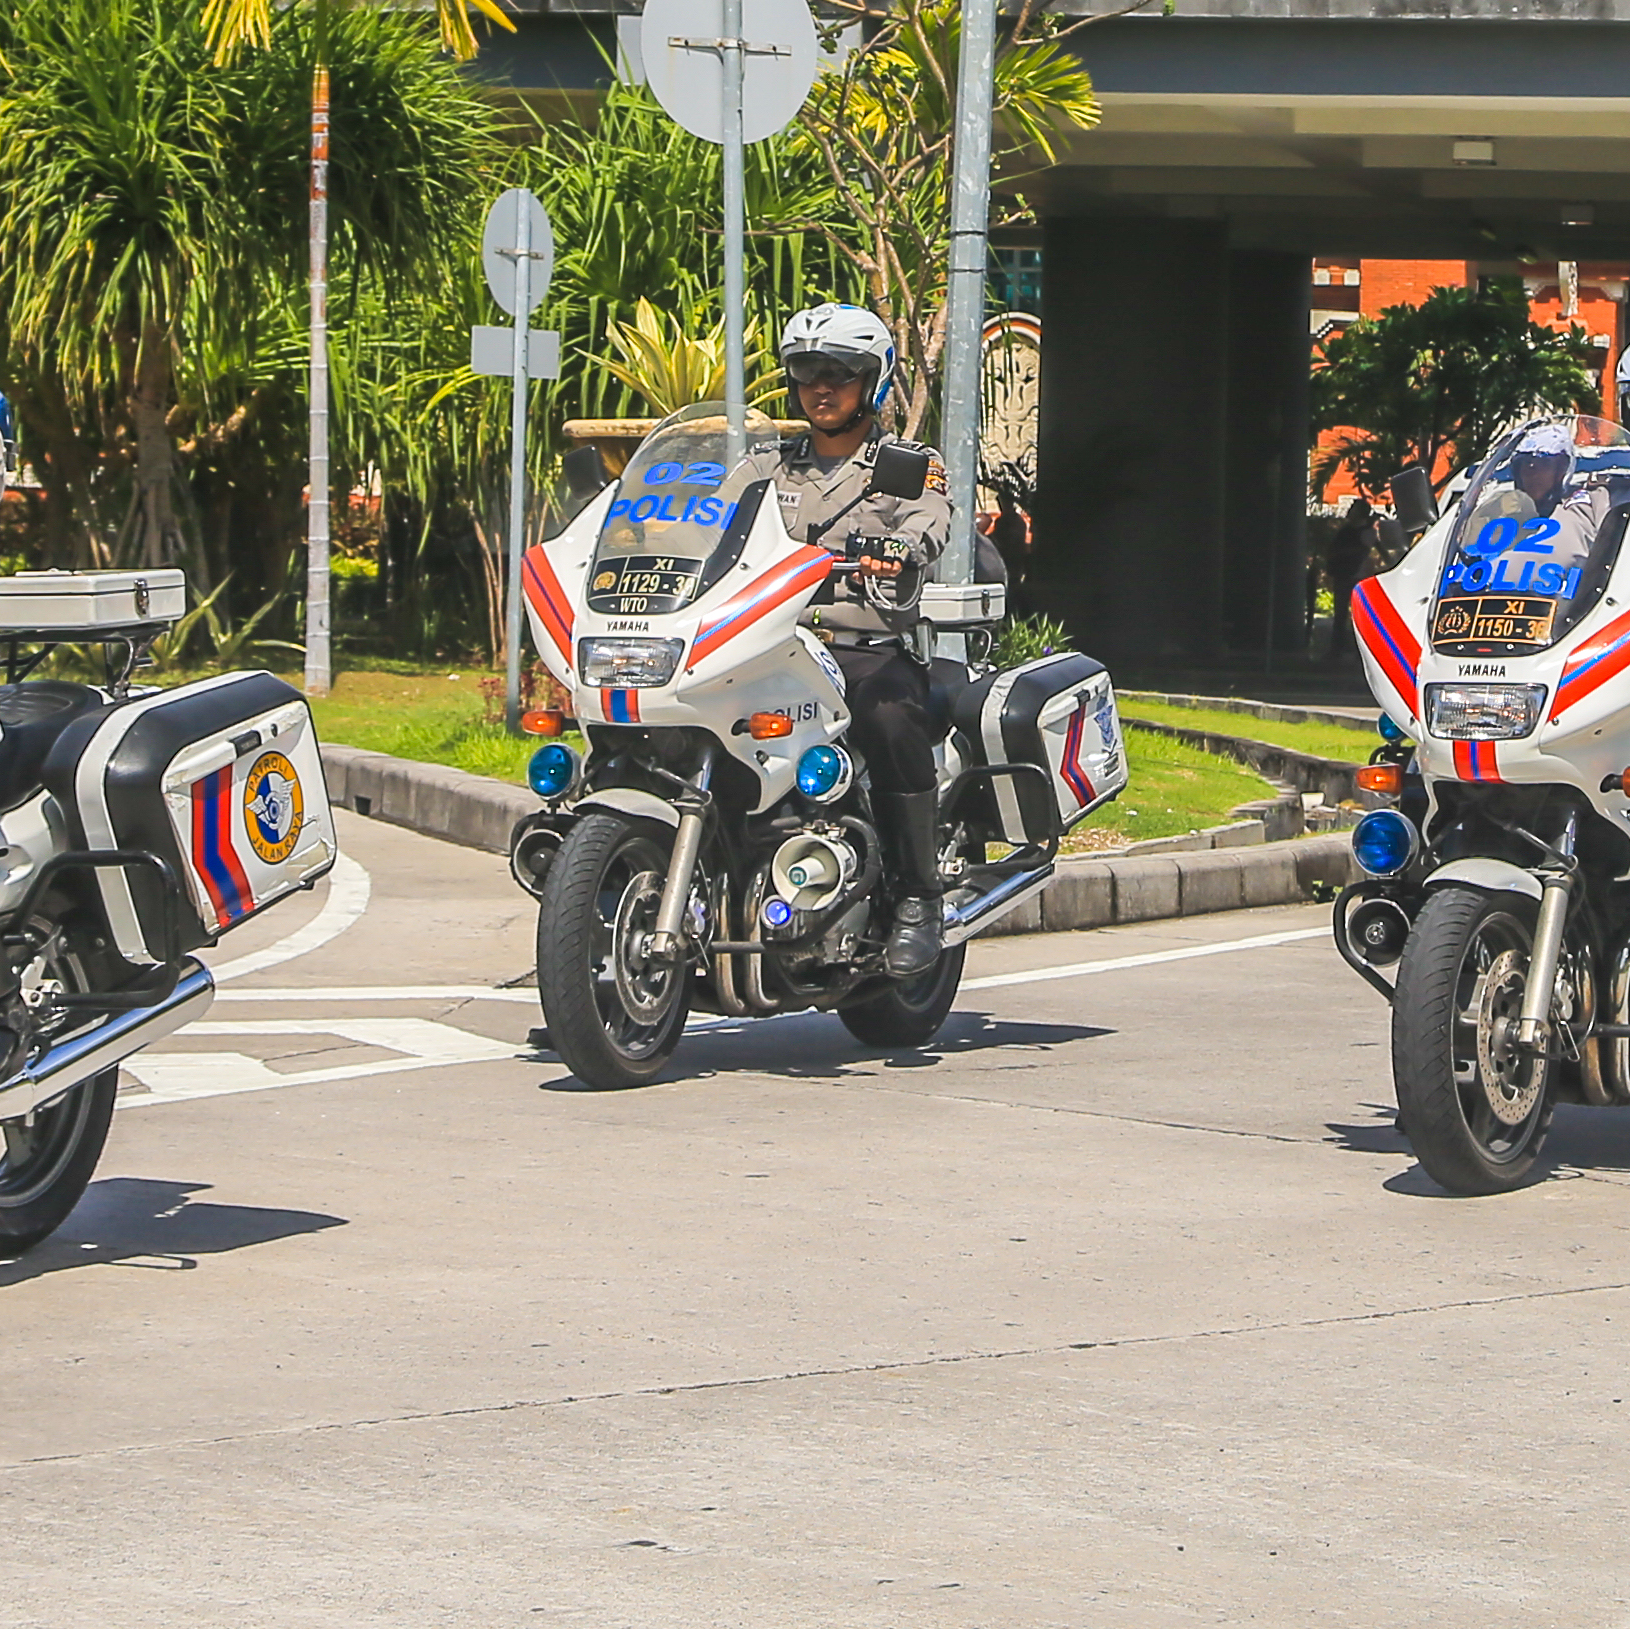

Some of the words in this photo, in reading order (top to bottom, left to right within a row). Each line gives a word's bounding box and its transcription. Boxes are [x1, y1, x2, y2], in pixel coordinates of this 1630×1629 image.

[643, 462, 727, 486] 02
[778, 494, 796, 504] WAN
[603, 494, 740, 530] POLISI
[1476, 517, 1561, 554] 02
[652, 558, 675, 570] XI
[622, 574, 661, 593] 1129
[1439, 560, 1583, 600] POLISI
[620, 598, 648, 613] WTO
[1504, 601, 1526, 614] XI
[607, 621, 650, 632] YAMAHA
[1477, 619, 1514, 637] 1150
[1458, 664, 1506, 677] YAMAHA
[762, 702, 818, 722] LISI
[248, 757, 288, 792] PATROLI
[252, 837, 283, 859] JALAN
